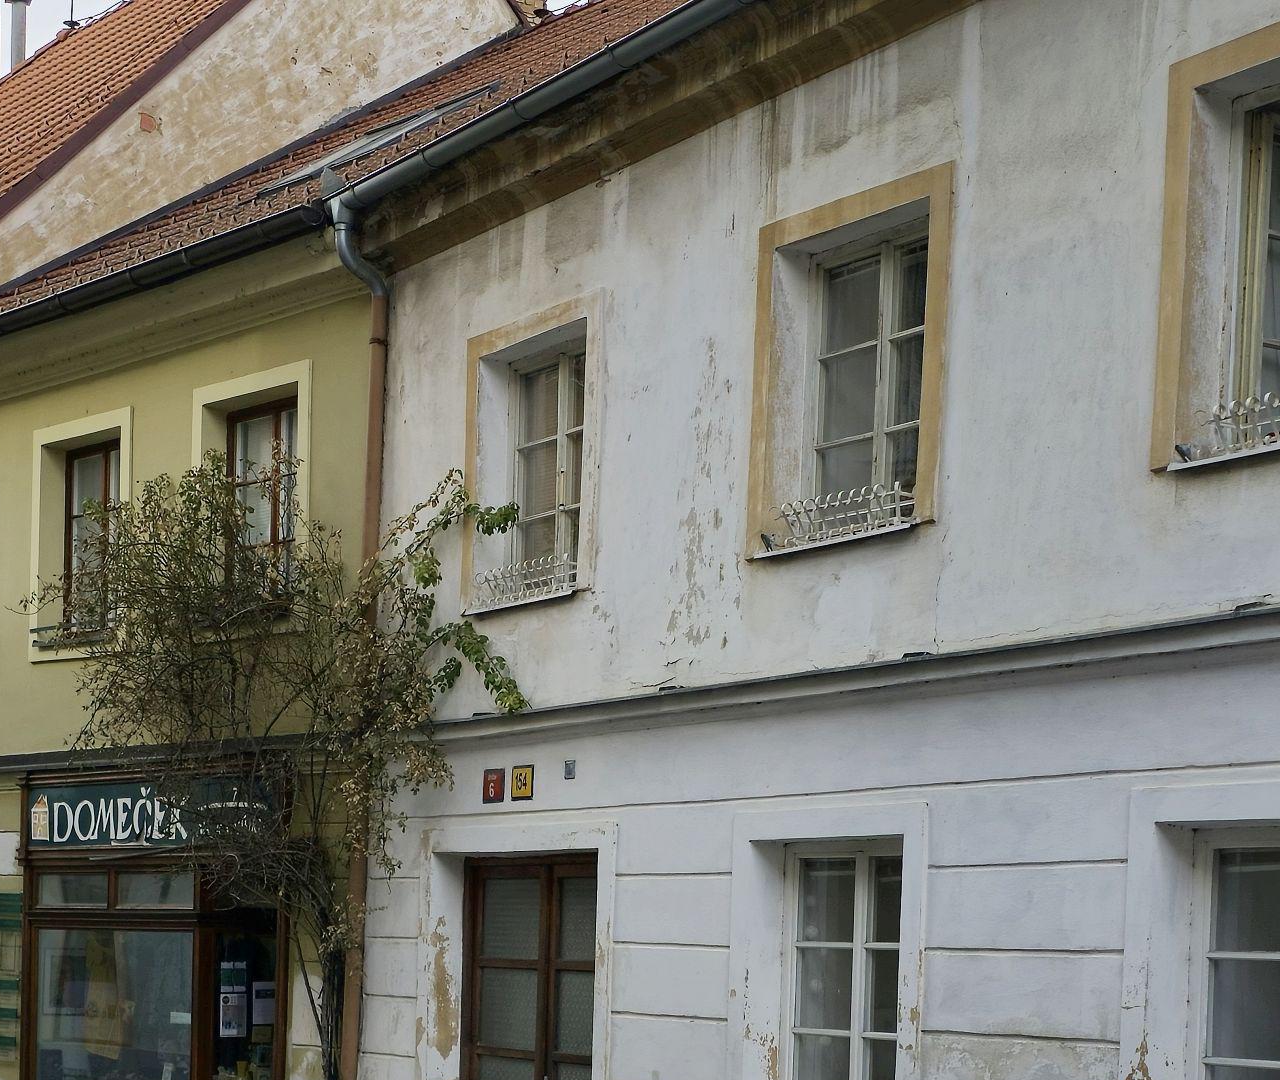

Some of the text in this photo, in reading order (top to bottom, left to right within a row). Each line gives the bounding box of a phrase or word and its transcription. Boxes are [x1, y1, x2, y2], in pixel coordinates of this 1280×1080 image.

[489, 782, 495, 798] 6
[515, 772, 528, 791] 154
[53, 786, 188, 844] DOMEČEK
